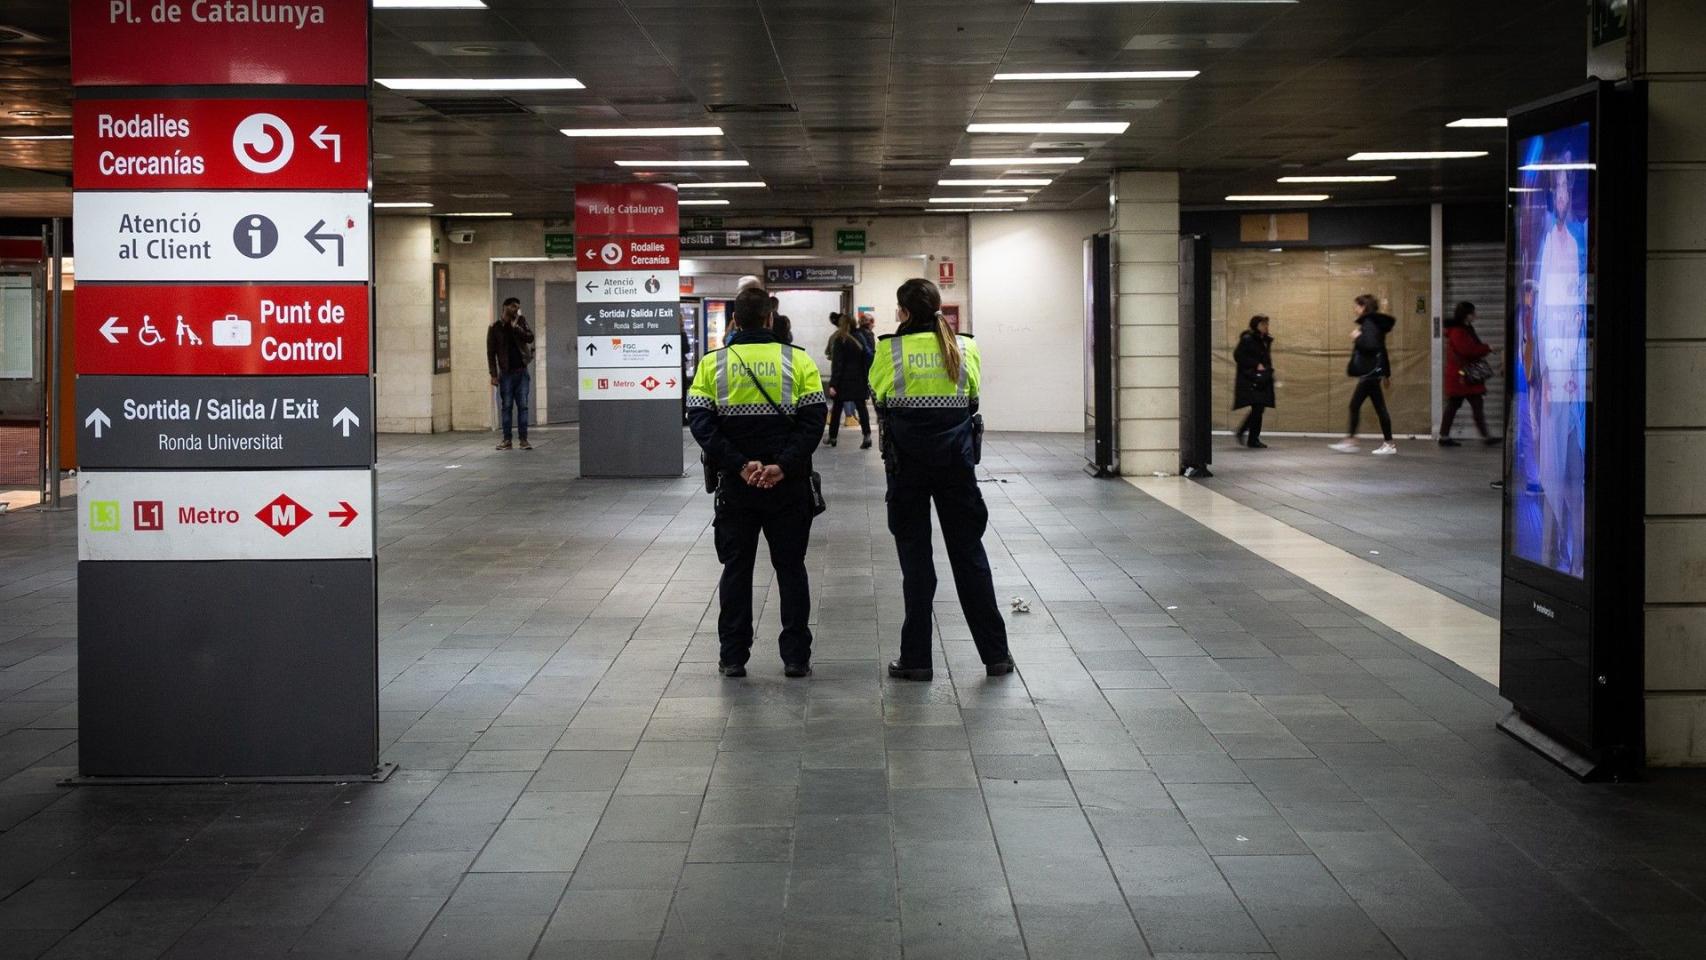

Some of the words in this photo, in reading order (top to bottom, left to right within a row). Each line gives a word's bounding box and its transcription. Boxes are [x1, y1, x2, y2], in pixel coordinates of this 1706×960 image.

[110, 0, 142, 24] Pl.
[150, 0, 182, 23] de
[191, 0, 325, 29] Catalunya
[98, 113, 191, 139] Rodalies
[98, 149, 206, 176] Cercanías
[588, 204, 601, 215] Pl.
[603, 204, 615, 215] de
[618, 204, 664, 216] Catalunya
[119, 213, 201, 234] Atenció
[631, 242, 665, 252] Rodalies
[678, 234, 714, 244] ersitat
[118, 239, 138, 260] al
[146, 239, 212, 260] Client
[631, 255, 670, 265] Cercanías
[604, 278, 634, 287] Atenció
[604, 287, 612, 295] al
[614, 287, 638, 296] Client
[260, 300, 312, 325] Punt
[317, 300, 346, 324] de
[599, 309, 626, 319] Sortida
[631, 308, 654, 318] Salida
[659, 308, 674, 318] Exit
[261, 336, 343, 362] Control
[908, 353, 944, 369] POLIC
[613, 380, 636, 388] Metro
[123, 398, 191, 421] Sortida
[195, 399, 202, 421] /
[206, 398, 266, 421] Salida
[269, 399, 277, 421] /
[282, 398, 320, 420] Exit
[158, 433, 203, 451] Ronda
[207, 433, 284, 451] Universitat
[91, 502, 119, 530] L3
[137, 503, 161, 529] L1
[178, 506, 240, 525] Metro
[272, 504, 297, 527] M
